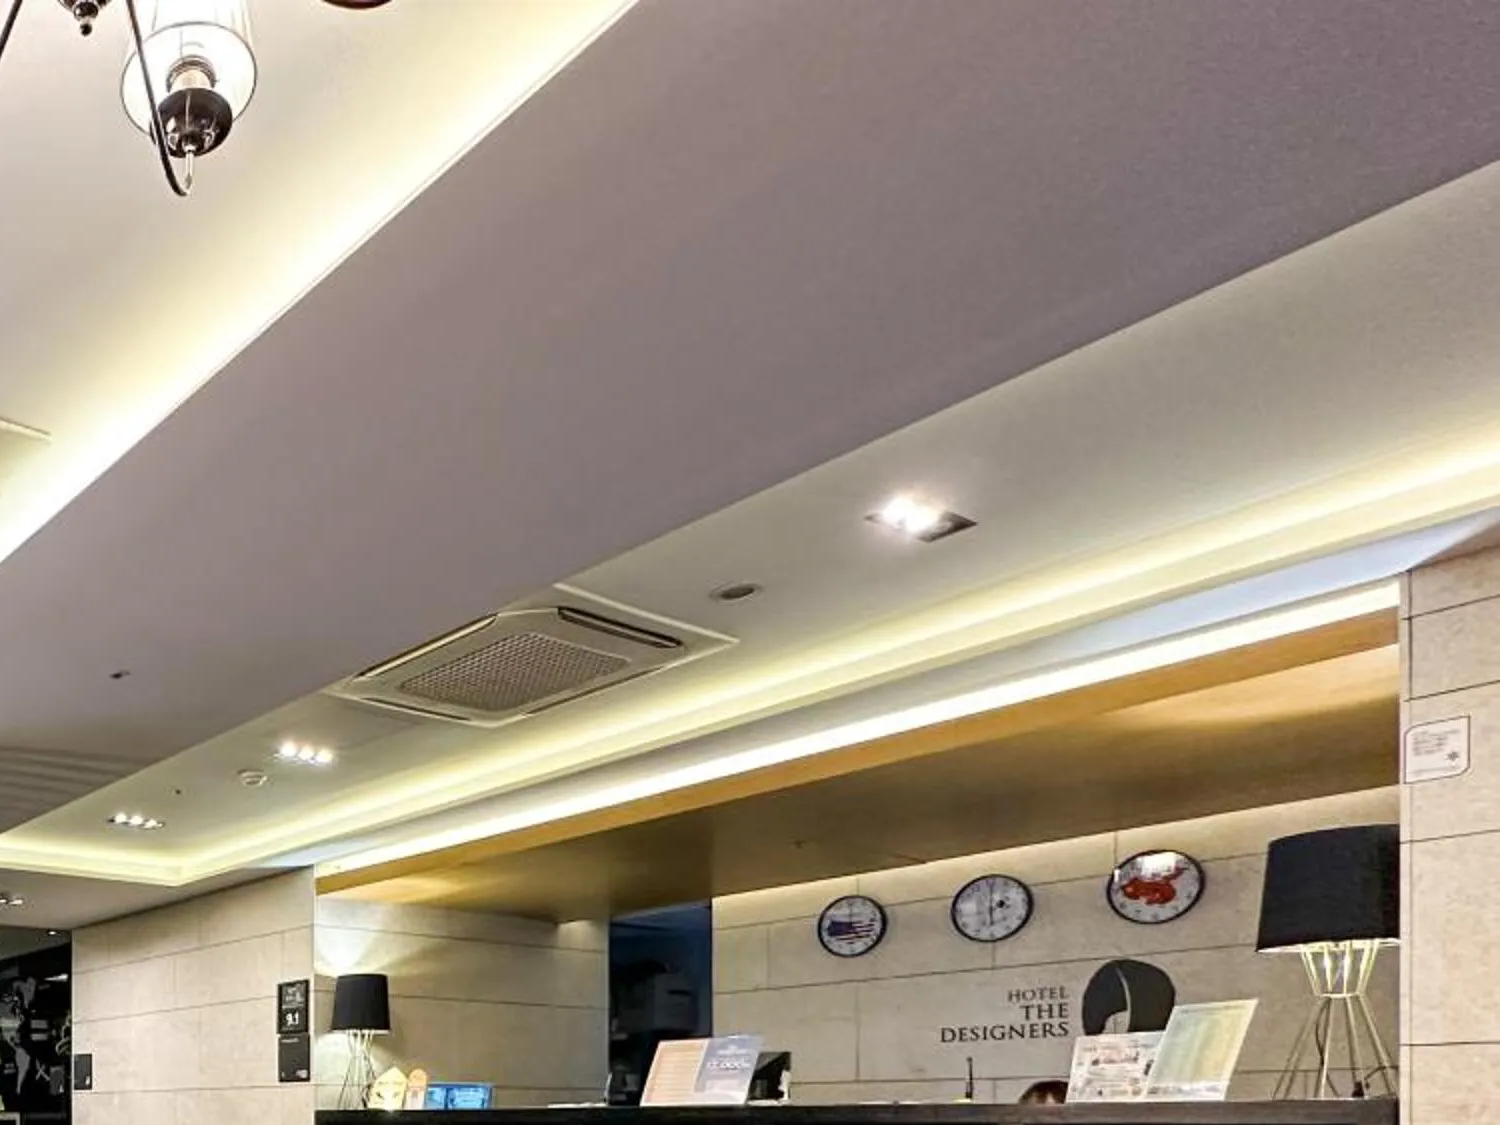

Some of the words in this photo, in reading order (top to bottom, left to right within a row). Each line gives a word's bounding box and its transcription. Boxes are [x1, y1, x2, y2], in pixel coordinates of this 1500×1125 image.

[1006, 985, 1069, 1003] HOTEL
[1019, 1002, 1070, 1021] THE
[940, 1021, 1070, 1043] DESIGNERS
